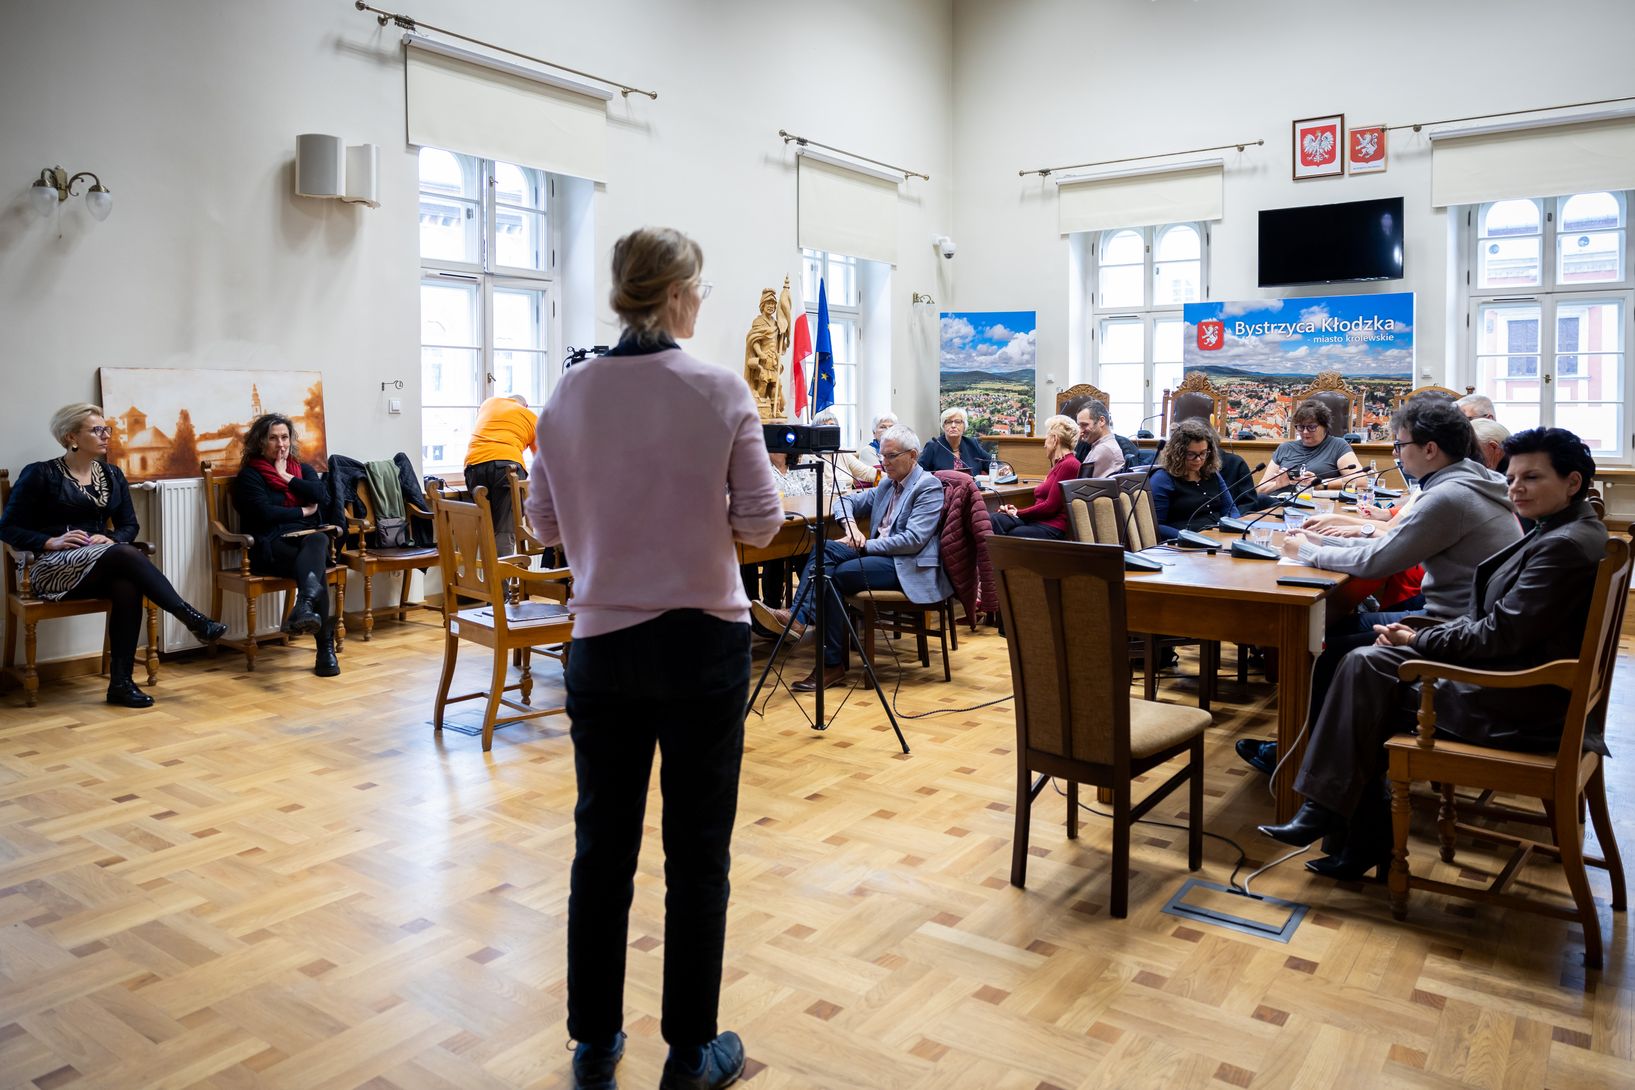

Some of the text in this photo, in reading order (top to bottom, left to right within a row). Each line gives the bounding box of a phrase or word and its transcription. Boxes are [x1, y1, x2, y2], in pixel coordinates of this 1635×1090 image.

[1235, 316, 1394, 338] Bystrzyca Kłodzka
[1313, 335, 1343, 343] miasto
